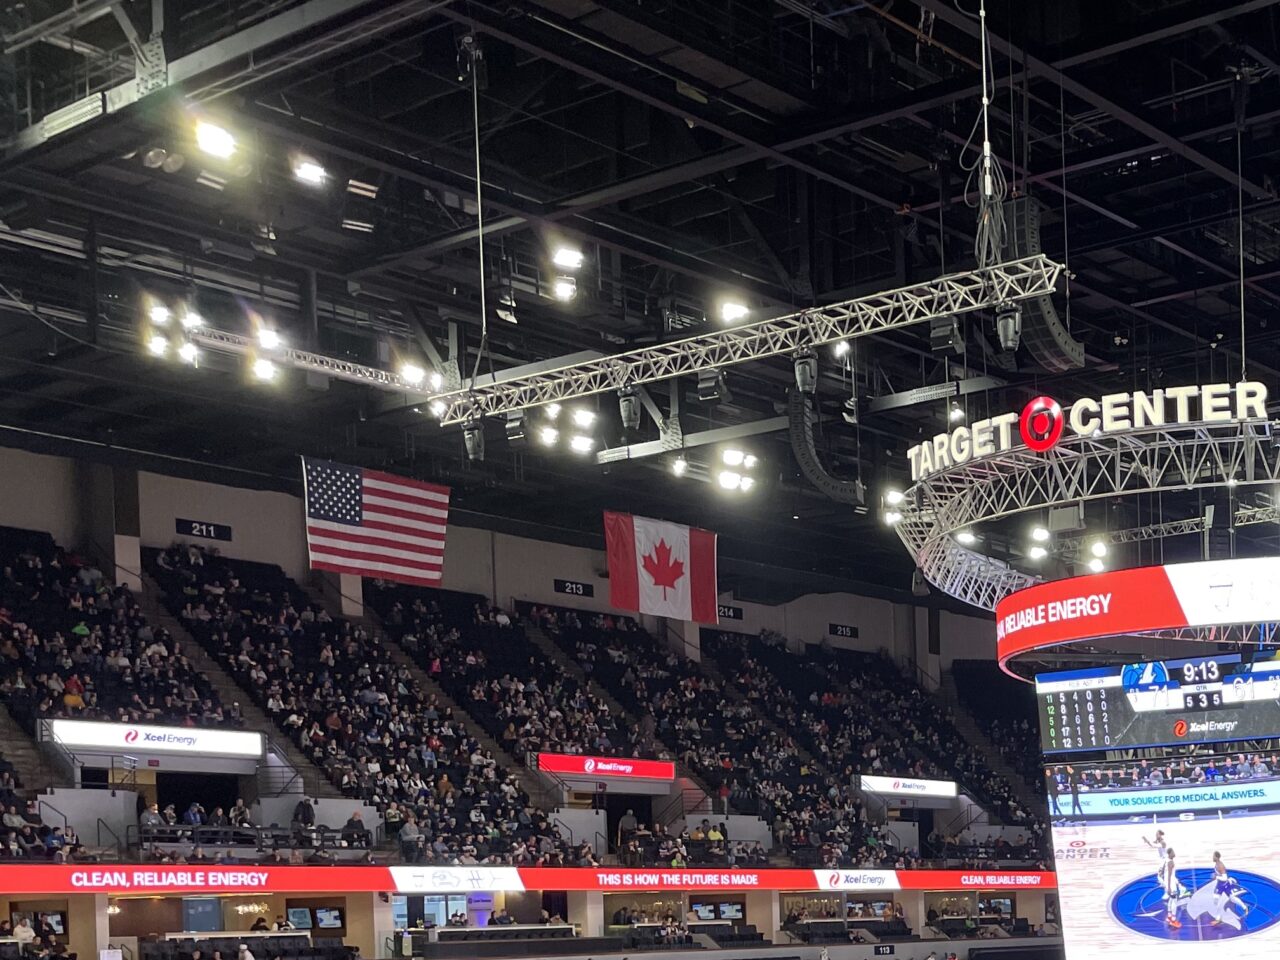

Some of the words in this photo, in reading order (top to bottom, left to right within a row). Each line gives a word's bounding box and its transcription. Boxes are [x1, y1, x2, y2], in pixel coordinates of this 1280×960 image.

[906, 411, 1019, 482] TARGET
[1069, 380, 1269, 437] CENTER
[191, 522, 216, 538] 211
[565, 582, 584, 595] 213
[719, 606, 734, 618] 214
[1005, 603, 1046, 634] RELIABLE
[1048, 593, 1112, 623] ENERGY
[836, 625, 852, 637] 215
[1183, 660, 1219, 682] 9:13
[1186, 696, 1193, 707] 5
[1199, 695, 1208, 707] 3
[1213, 695, 1220, 705] 5
[1047, 706, 1055, 714] 12
[1061, 727, 1070, 736] 17
[1189, 720, 1209, 732] Xcel
[1209, 719, 1236, 732] Energy
[143, 732, 166, 742] Xcel
[167, 734, 198, 746] Energy
[1062, 738, 1071, 748] 12
[597, 761, 613, 771] Xcel
[613, 762, 633, 773] Energy
[1108, 796, 1131, 808] YOUR
[1131, 794, 1164, 806] SOURCE
[1165, 793, 1181, 804] FOR
[1182, 790, 1220, 803] MEDICAL
[1221, 788, 1267, 801] ANSWERS.
[71, 871, 131, 888] CLEAN,
[133, 872, 205, 887] RELIABLE
[208, 872, 268, 886] ENERGY
[597, 873, 621, 885] THIS
[623, 873, 632, 885] IS
[634, 873, 659, 885] HOW
[662, 874, 680, 885] THE
[682, 874, 719, 885] FUTURE
[721, 874, 730, 885] IS
[731, 874, 759, 885] MADE
[843, 874, 861, 884] Xcel
[861, 874, 885, 887] Energy
[960, 875, 985, 885] CLEAN,
[985, 875, 1015, 885] RELIABLE
[1016, 875, 1041, 885] ENERGY
[878, 946, 891, 954] 113
